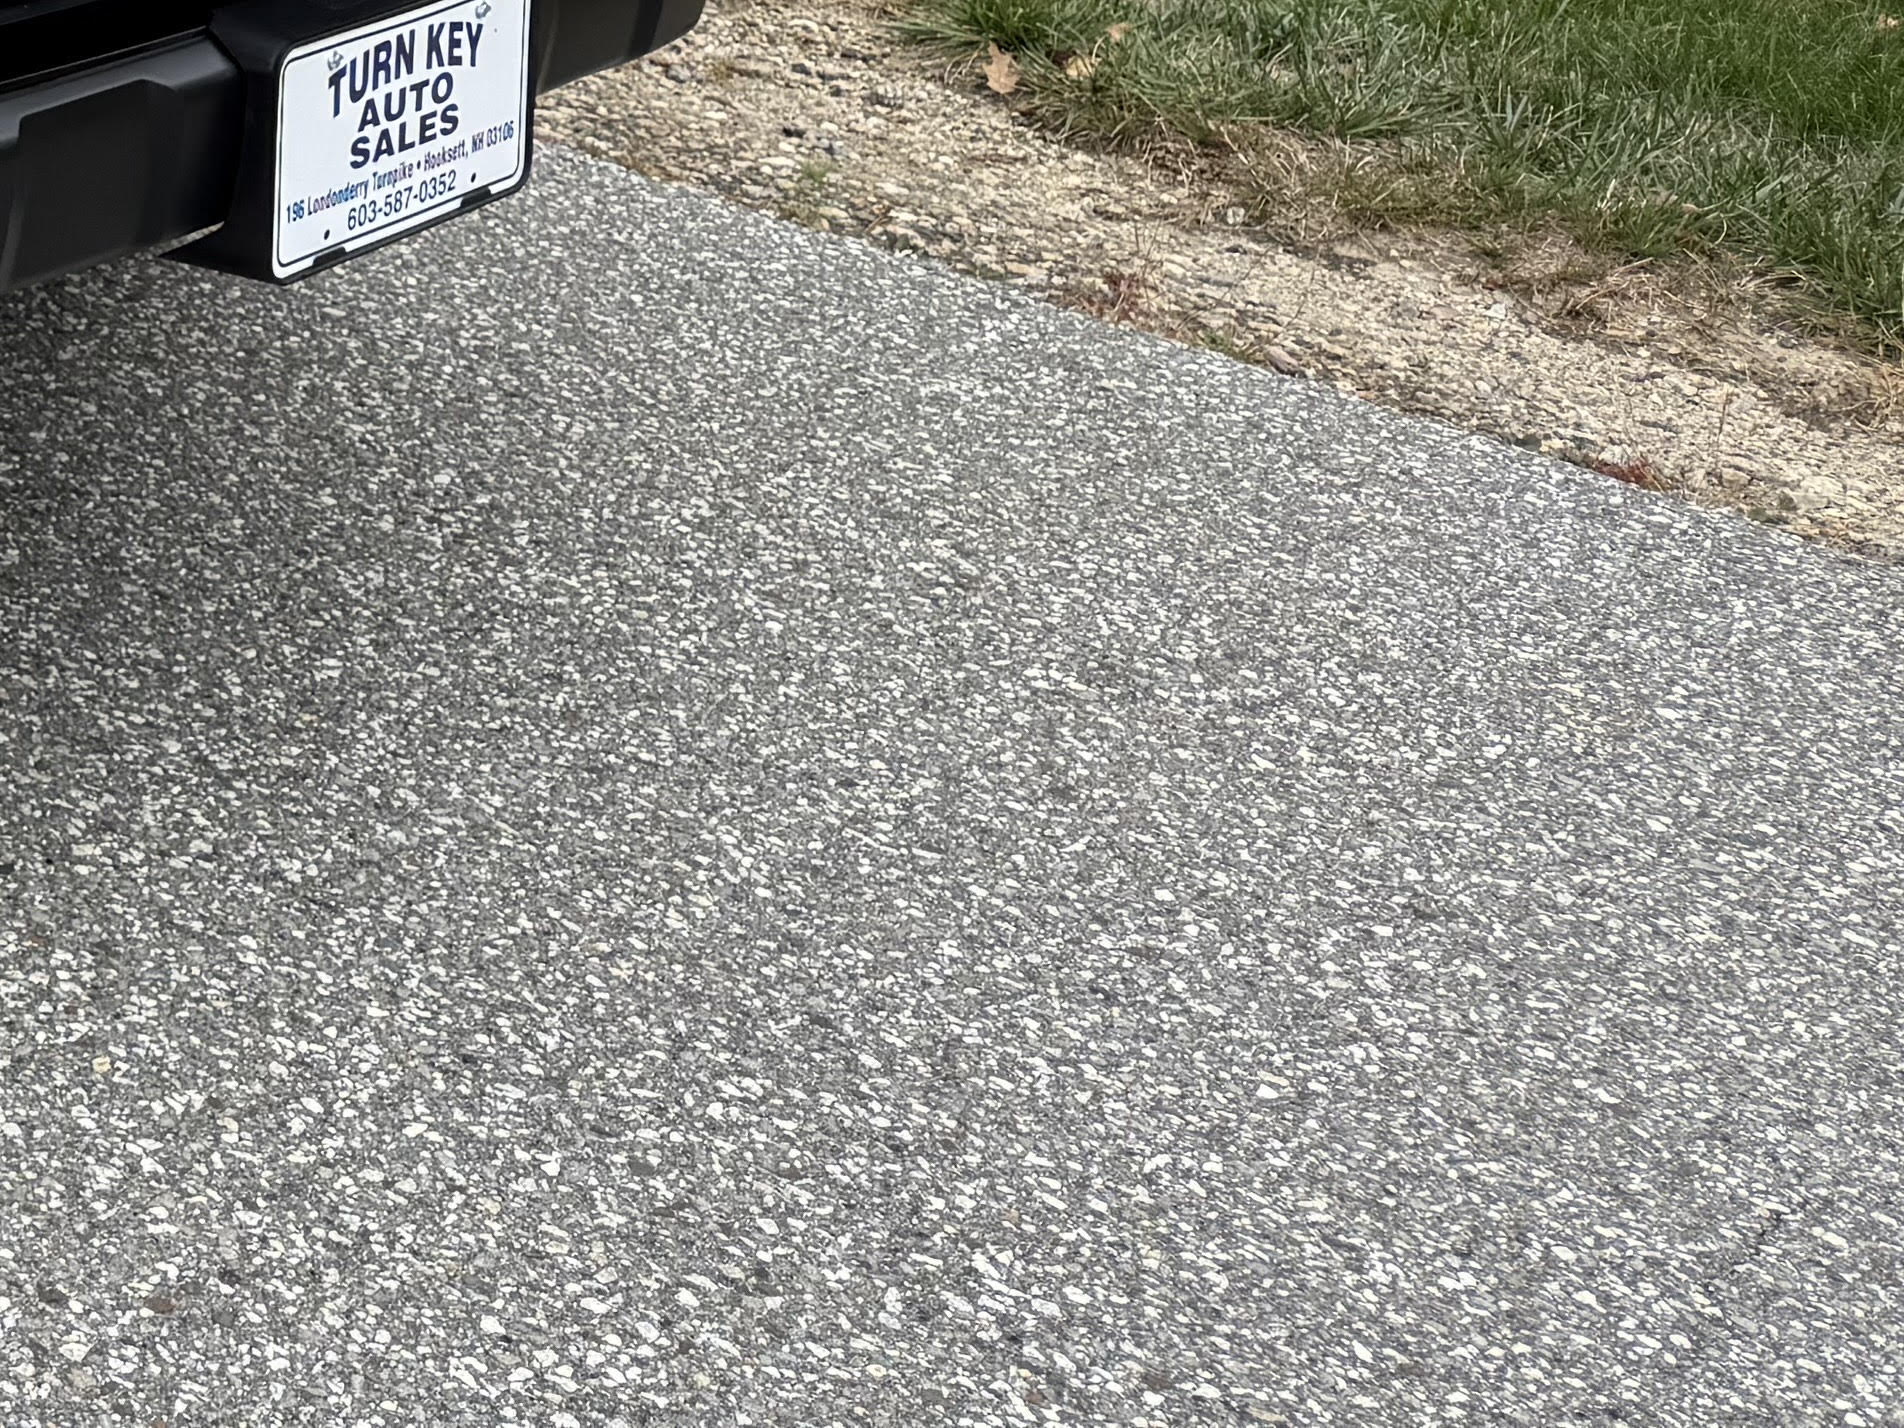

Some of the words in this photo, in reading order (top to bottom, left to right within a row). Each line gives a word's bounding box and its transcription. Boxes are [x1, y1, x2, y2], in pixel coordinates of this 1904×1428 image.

[328, 29, 415, 119] TURN
[426, 20, 484, 70] KEY
[357, 71, 454, 132] AUTO
[349, 103, 460, 170] SALES
[286, 199, 306, 224] 196
[307, 179, 370, 217] Londonderry
[372, 162, 414, 191] Turnpike
[423, 145, 469, 172] Hooksett,
[471, 131, 485, 153] NH
[486, 120, 515, 148] 03106
[347, 169, 457, 231] 603-587-0352
